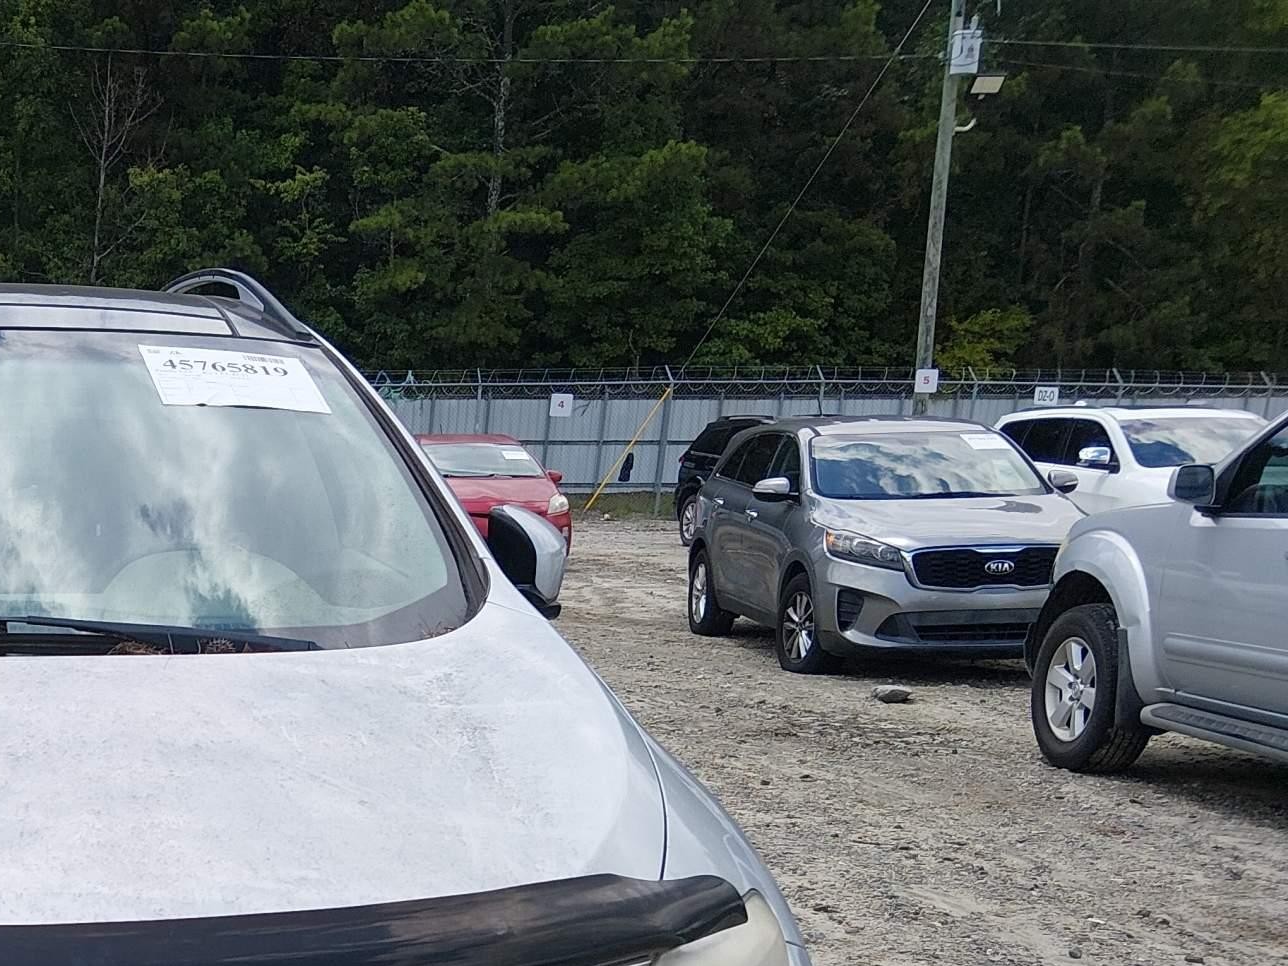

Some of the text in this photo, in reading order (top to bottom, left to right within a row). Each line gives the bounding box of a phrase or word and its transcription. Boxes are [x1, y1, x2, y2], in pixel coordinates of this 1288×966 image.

[162, 359, 289, 377] 45765819
[557, 400, 565, 409] 4
[990, 562, 1010, 572] KIA
